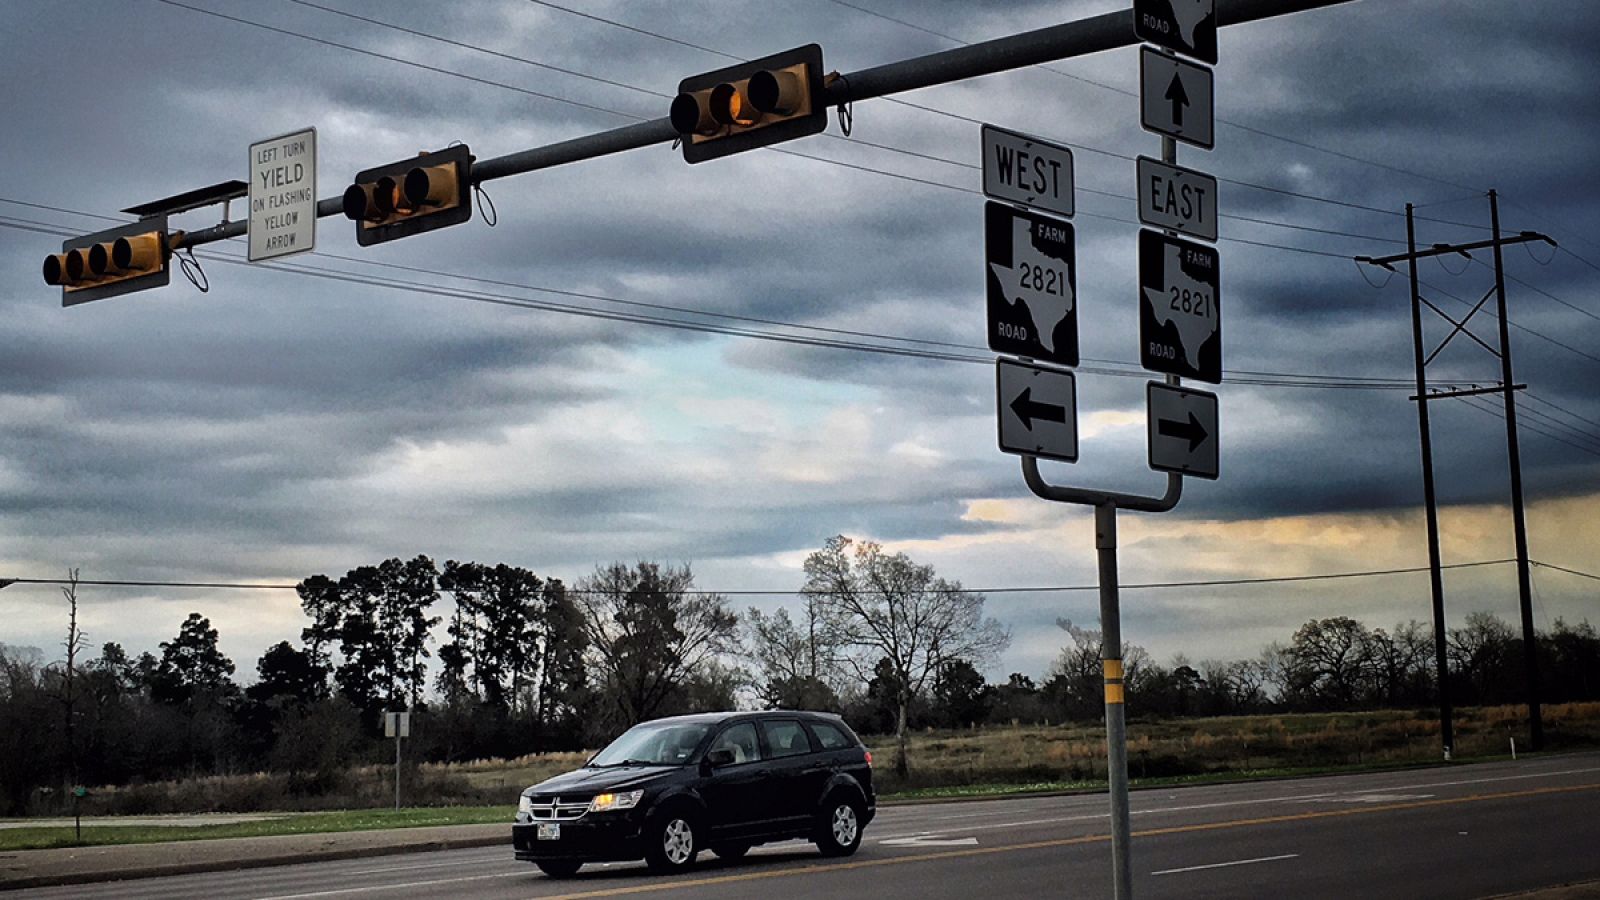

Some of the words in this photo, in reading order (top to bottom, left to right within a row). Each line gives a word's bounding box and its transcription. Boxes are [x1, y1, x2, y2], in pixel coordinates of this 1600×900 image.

[1143, 12, 1169, 34] ROAD
[258, 147, 277, 164] LEFT
[283, 142, 305, 158] TURN
[261, 163, 303, 188] YIELD
[995, 143, 1062, 199] WEST
[253, 199, 264, 212] ON
[269, 188, 311, 208] FLASHING
[1151, 174, 1206, 224] EAST
[265, 212, 298, 230] YELLOW
[266, 233, 296, 250] ARROW
[1037, 223, 1067, 245] FARM
[1186, 250, 1213, 269] FARM
[1019, 262, 1065, 297] 2821
[1169, 286, 1210, 319] 2821
[997, 321, 1028, 341] ROAD
[1149, 342, 1176, 360] ROAD
